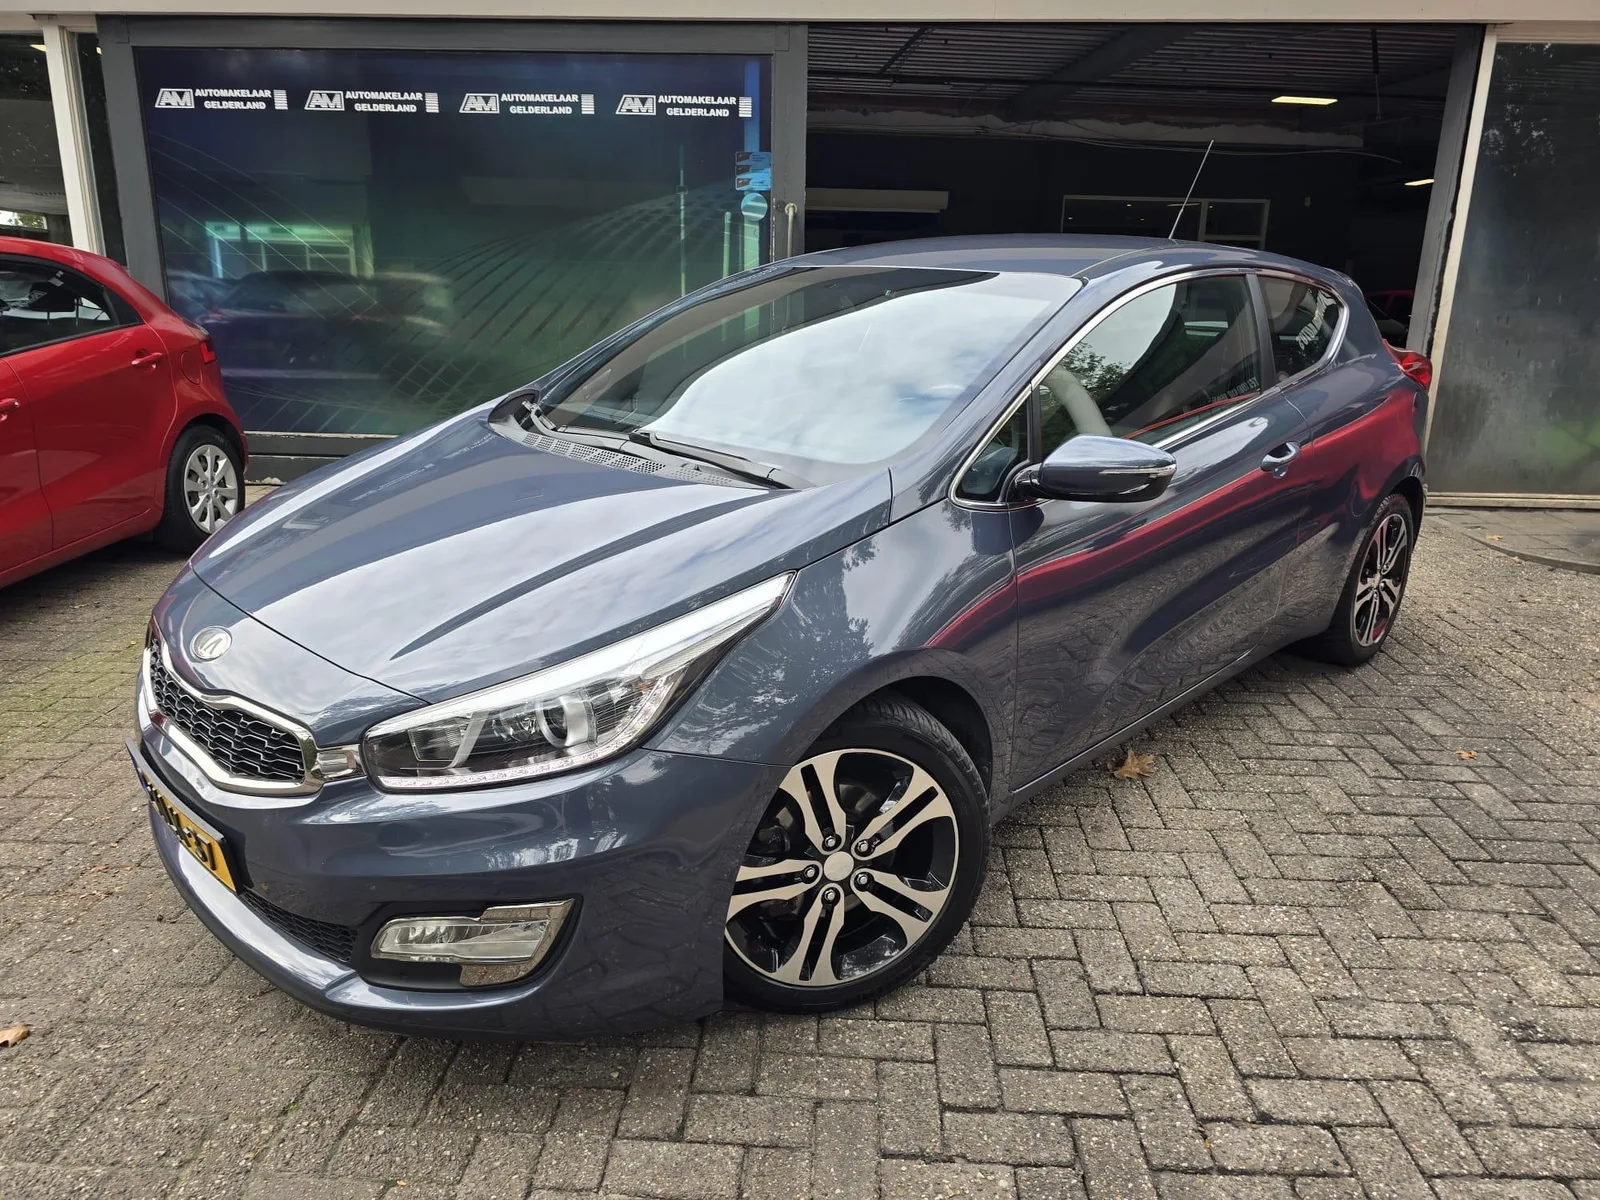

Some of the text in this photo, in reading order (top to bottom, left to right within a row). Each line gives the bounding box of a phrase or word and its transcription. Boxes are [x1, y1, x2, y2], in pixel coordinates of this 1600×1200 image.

[195, 88, 272, 98] AUTOMAKELAAR
[345, 91, 423, 101] AUTOMAKELAAR
[500, 93, 579, 103] AUTOMAKELAAR
[204, 100, 266, 110] GELDERLAND
[658, 95, 736, 105] AUTOMAKELAAR
[354, 103, 417, 113] GELDERLAND
[509, 105, 573, 115] GELDERLAND
[666, 107, 729, 117] GELDERLAND
